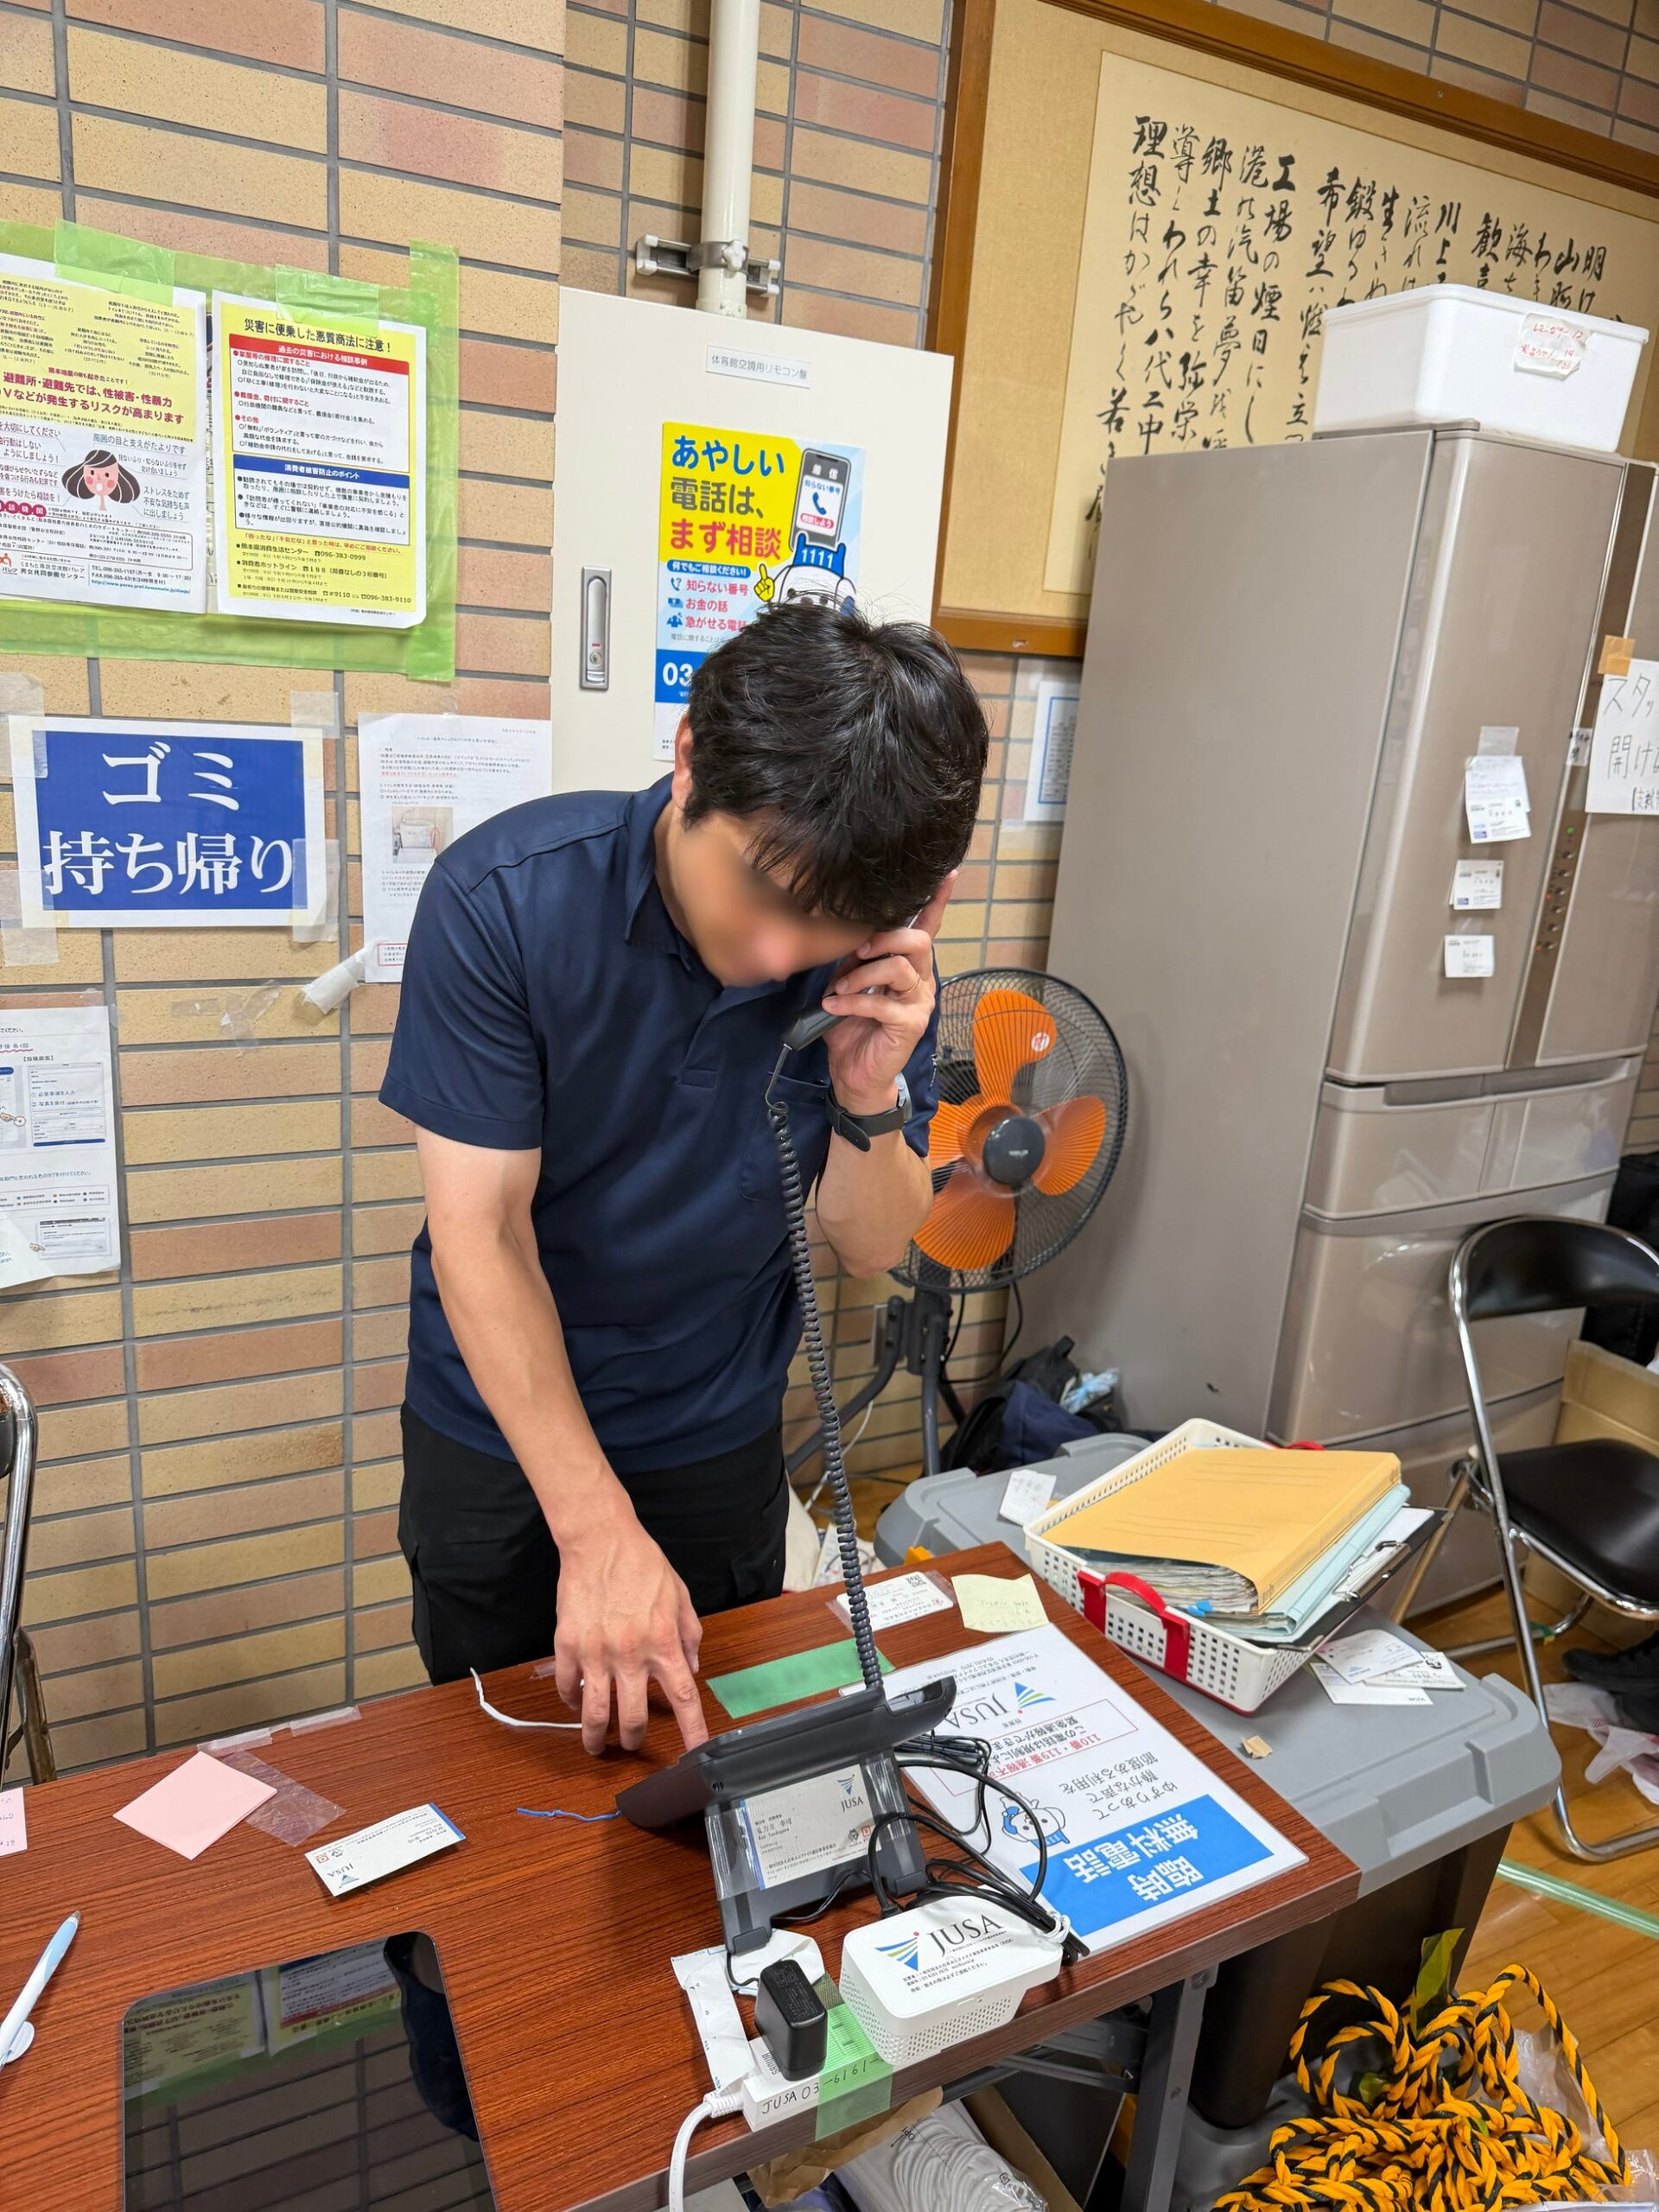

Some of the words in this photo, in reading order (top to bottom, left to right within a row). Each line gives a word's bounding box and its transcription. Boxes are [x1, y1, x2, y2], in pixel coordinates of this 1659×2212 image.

[245, 318, 391, 353] 災害に便乗した悪質商法に注意！
[3, 372, 172, 408] 避難所・避難先では、性被害・性暴力
[671, 435, 785, 477] あやしい
[143, 486, 190, 499] ストレスをためず
[143, 497, 190, 510] 不安な気持ちも声
[671, 476, 765, 518] 電話は、
[804, 480, 841, 495] 知らない番号
[671, 519, 782, 560] まず相談
[802, 549, 834, 569] 1111
[685, 598, 728, 613] お金の話
[686, 580, 748, 596] 知らない番号
[102, 741, 240, 810] ゴミ
[43, 830, 293, 895] 持ち帰り
[939, 1693, 1010, 1733] JUSA
[1057, 1749, 1159, 1797] 節度ある利用を
[1083, 1767, 1160, 1806] 静かな声で
[839, 1793, 864, 1812] JUSA
[1089, 1778, 1180, 1821] ゆずりあって
[1059, 1810, 1205, 1885] 無料電話
[326, 1863, 354, 1878] JUSA
[1122, 1853, 1207, 1904] 臨時
[921, 1910, 1009, 1957] JUSA
[760, 2089, 798, 2115] JUSA
[798, 2054, 887, 2099] 03-6161-
